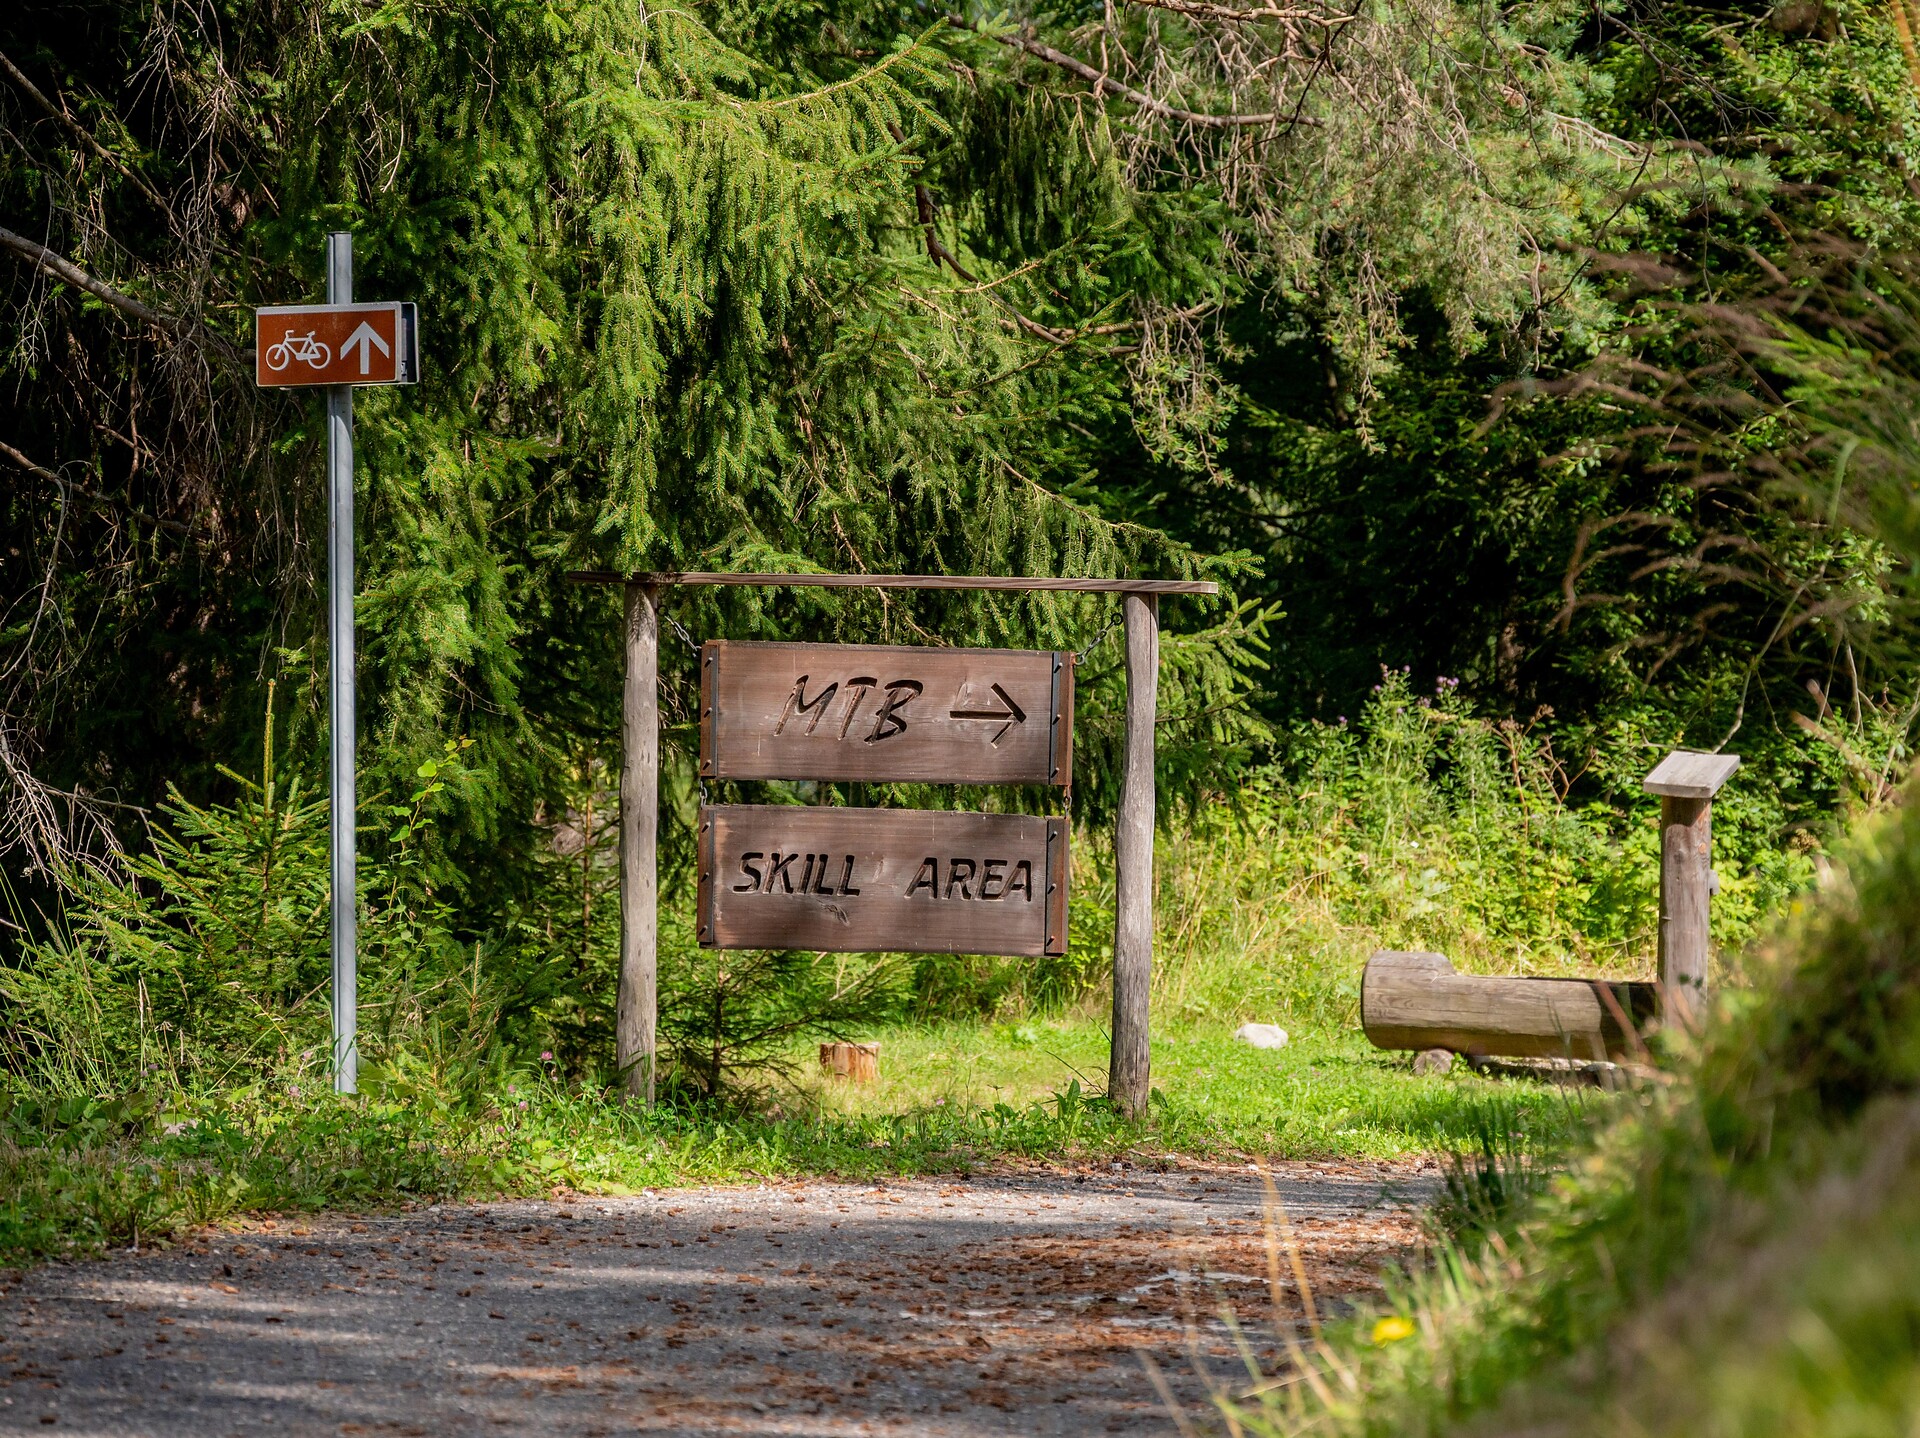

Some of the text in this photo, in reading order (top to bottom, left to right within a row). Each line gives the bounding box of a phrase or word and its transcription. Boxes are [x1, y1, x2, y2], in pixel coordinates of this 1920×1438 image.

[773, 675, 924, 746] MTB
[732, 851, 1033, 903] SKILL AREA
